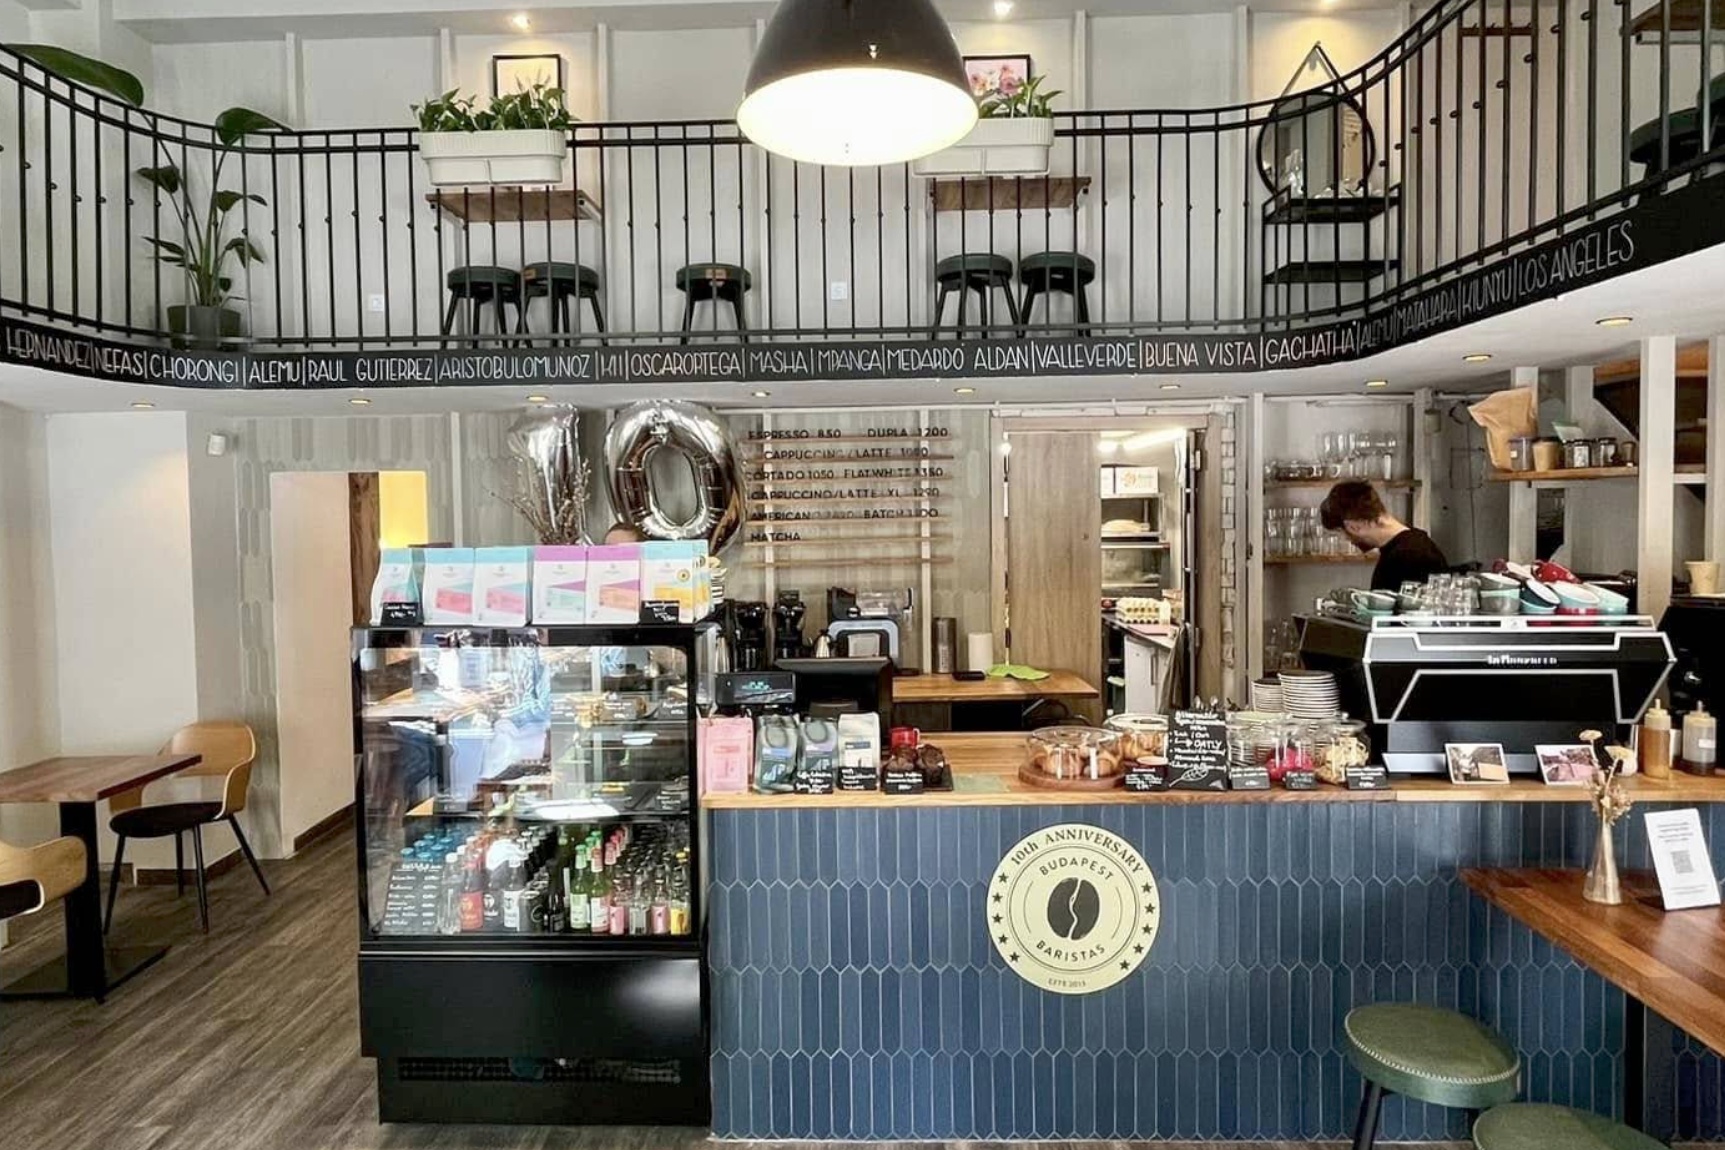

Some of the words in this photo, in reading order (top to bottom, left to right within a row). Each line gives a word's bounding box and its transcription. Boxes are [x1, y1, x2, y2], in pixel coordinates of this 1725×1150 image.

[249, 360, 301, 384] ALEMU
[308, 358, 350, 382] RAUL
[356, 357, 434, 382] GUTIERREZ
[750, 349, 808, 373] MASHA
[818, 348, 882, 373] MPANGA
[887, 347, 964, 371] MEDARDO
[973, 346, 1029, 371] ALDAN
[1034, 341, 1136, 369] VALLEVERDE
[1145, 341, 1199, 368] BUENA
[1205, 340, 1256, 367] VISTA
[1519, 252, 1548, 296] LOS
[1550, 219, 1635, 285] ANGELES
[748, 429, 809, 440] ESPRESSO
[867, 427, 908, 438] DUPLA
[750, 532, 801, 542] MATCHA
[1193, 739, 1223, 750] OATLY
[1011, 840, 1039, 866] 10th
[1045, 829, 1144, 874] ANNIVERSARY
[1038, 857, 1114, 881] BUDAPEST
[1036, 940, 1106, 962] BARISTAS
